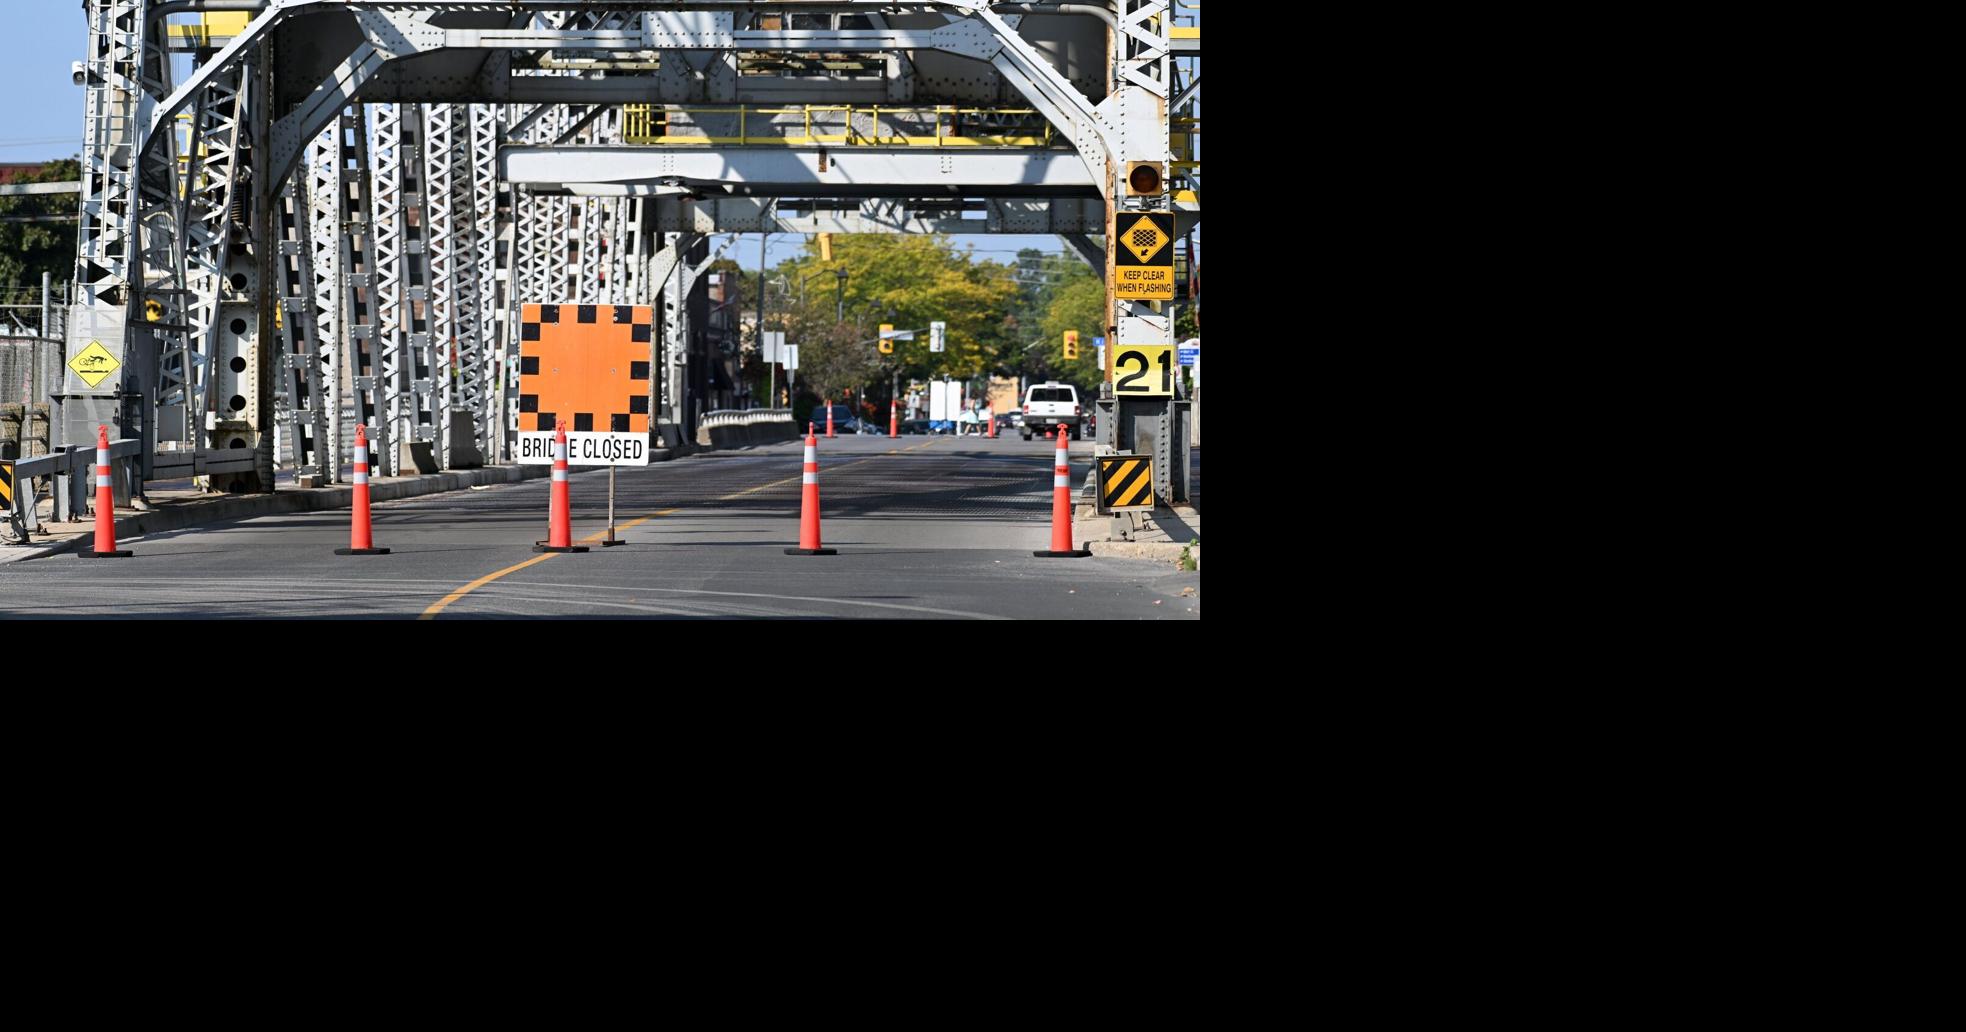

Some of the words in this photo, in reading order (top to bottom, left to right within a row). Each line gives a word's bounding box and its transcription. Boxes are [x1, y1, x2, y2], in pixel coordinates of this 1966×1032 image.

[1123, 270, 1142, 280] KEEP
[1142, 270, 1165, 281] CLEAR
[1116, 282, 1137, 293] WHEN
[1138, 282, 1172, 293] FLASHING
[1116, 350, 1171, 392] 21
[522, 437, 577, 458] BRIDE
[583, 438, 642, 459] CLOSED
